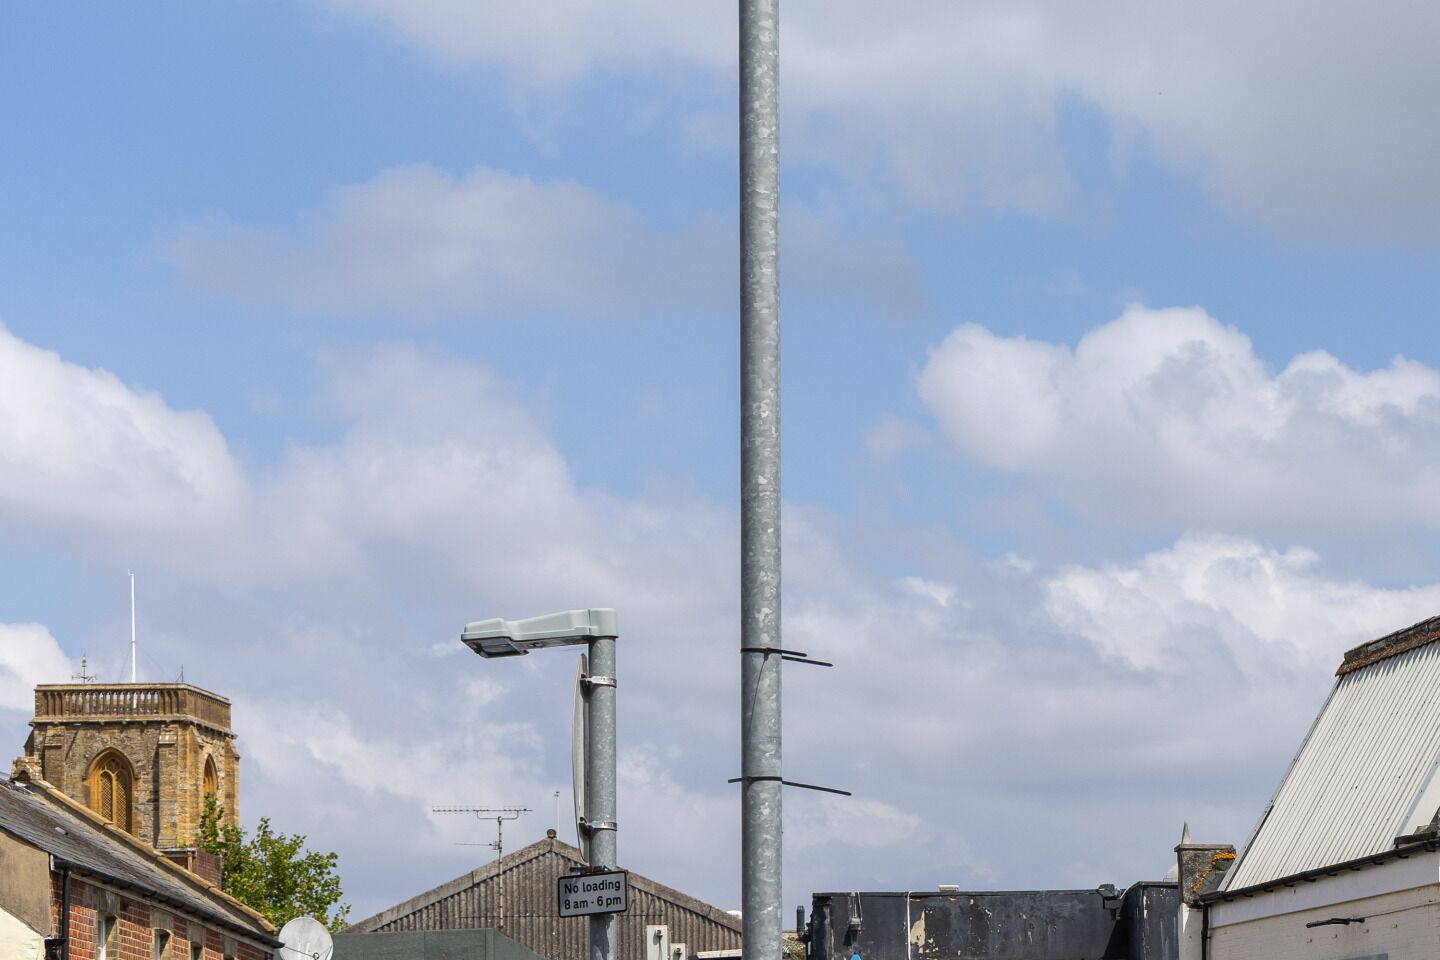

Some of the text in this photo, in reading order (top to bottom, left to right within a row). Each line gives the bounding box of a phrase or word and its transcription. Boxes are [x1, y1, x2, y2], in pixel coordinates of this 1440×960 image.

[564, 880, 620, 894] No loading
[564, 899, 571, 910] 8
[573, 900, 589, 909] am
[597, 896, 604, 906] 6
[606, 897, 622, 908] pm
